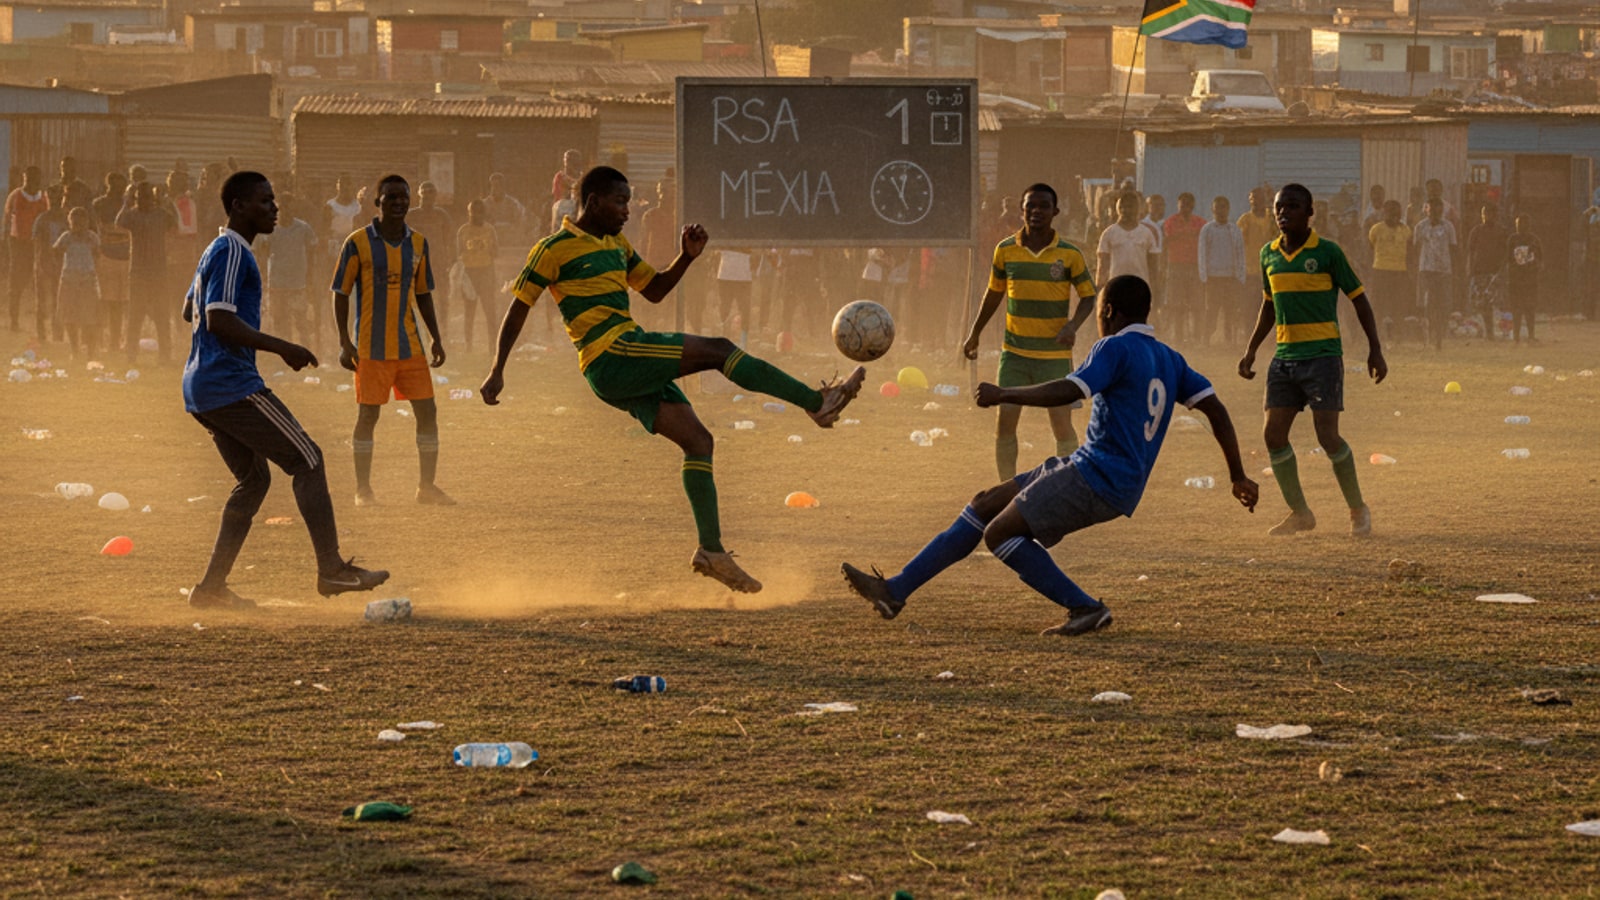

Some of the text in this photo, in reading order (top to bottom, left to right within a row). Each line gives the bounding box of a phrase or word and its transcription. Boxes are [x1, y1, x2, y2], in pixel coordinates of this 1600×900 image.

[712, 96, 910, 145] RSA 1
[719, 161, 841, 220] MÉXIA
[1143, 377, 1167, 442] 9
